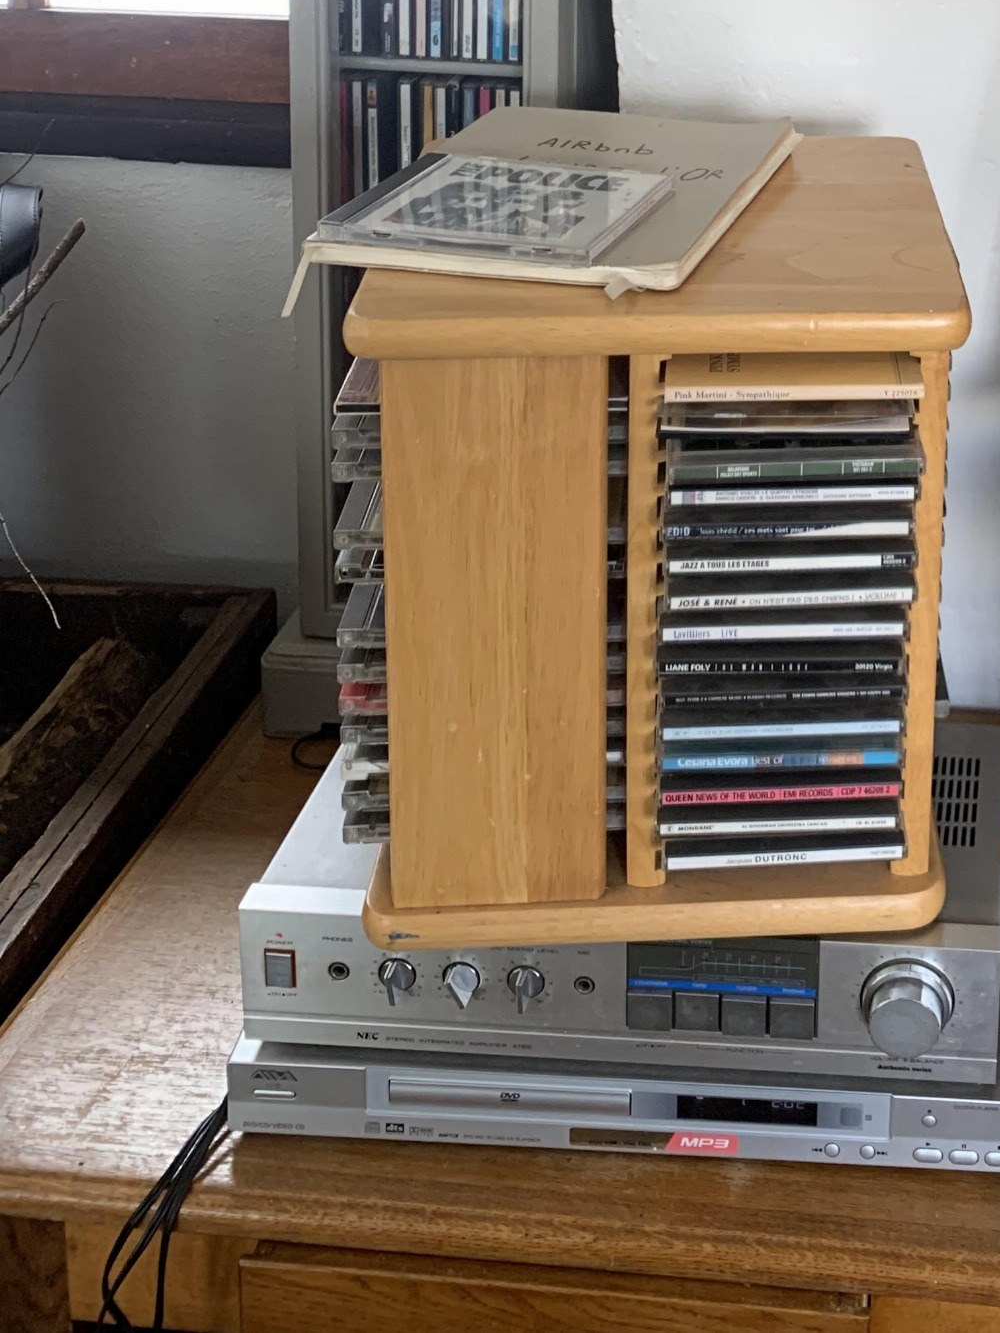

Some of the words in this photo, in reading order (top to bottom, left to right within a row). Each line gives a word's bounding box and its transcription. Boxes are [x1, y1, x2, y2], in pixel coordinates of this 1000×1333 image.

[537, 137, 654, 155] AIRbnb
[474, 166, 630, 192] POLICE
[674, 391, 693, 400] Pink
[695, 390, 728, 399] Martini
[736, 389, 791, 400] Sympathique
[700, 526, 714, 536] louis
[744, 527, 756, 535] ces
[756, 525, 773, 534] mots
[774, 525, 788, 534] sont
[790, 525, 806, 535] pour
[680, 561, 700, 570] JAZZ
[699, 561, 706, 570] A
[707, 561, 726, 570] TOUS
[727, 561, 741, 569] LES
[742, 560, 770, 569] ETAGES
[678, 598, 700, 608] JOSÉ
[703, 599, 711, 607] &
[714, 596, 738, 606] RENÉ
[749, 598, 762, 606] ON
[763, 597, 786, 605] N'EST
[786, 596, 802, 604] PAS
[803, 596, 820, 604] DES
[821, 595, 851, 603] CHIENS
[864, 593, 898, 601] VOLUME
[721, 629, 738, 638] LIVE
[665, 663, 690, 672] LIANE
[690, 663, 712, 672] FOLY
[874, 663, 894, 672] Virgin
[717, 757, 748, 767] Evora
[752, 755, 770, 765] Best
[772, 755, 784, 765] of
[664, 793, 694, 803] QUEEN
[695, 792, 718, 802] NEWS
[719, 792, 730, 801] OF
[732, 791, 746, 801] THE
[748, 790, 776, 800] WORLD
[783, 789, 798, 799] EMI
[798, 788, 834, 798] RECORDS
[840, 787, 857, 797] CDP
[754, 853, 808, 863] DUTRONC
[321, 935, 354, 943] PHONES
[356, 1031, 380, 1041] NEC
[385, 1035, 416, 1043] STEREO
[418, 1037, 466, 1047] INTEGRATED
[726, 1047, 764, 1055] FUNCTION
[294, 1122, 306, 1131] CD
[386, 1123, 404, 1133] dts
[680, 1137, 729, 1149] MP3
